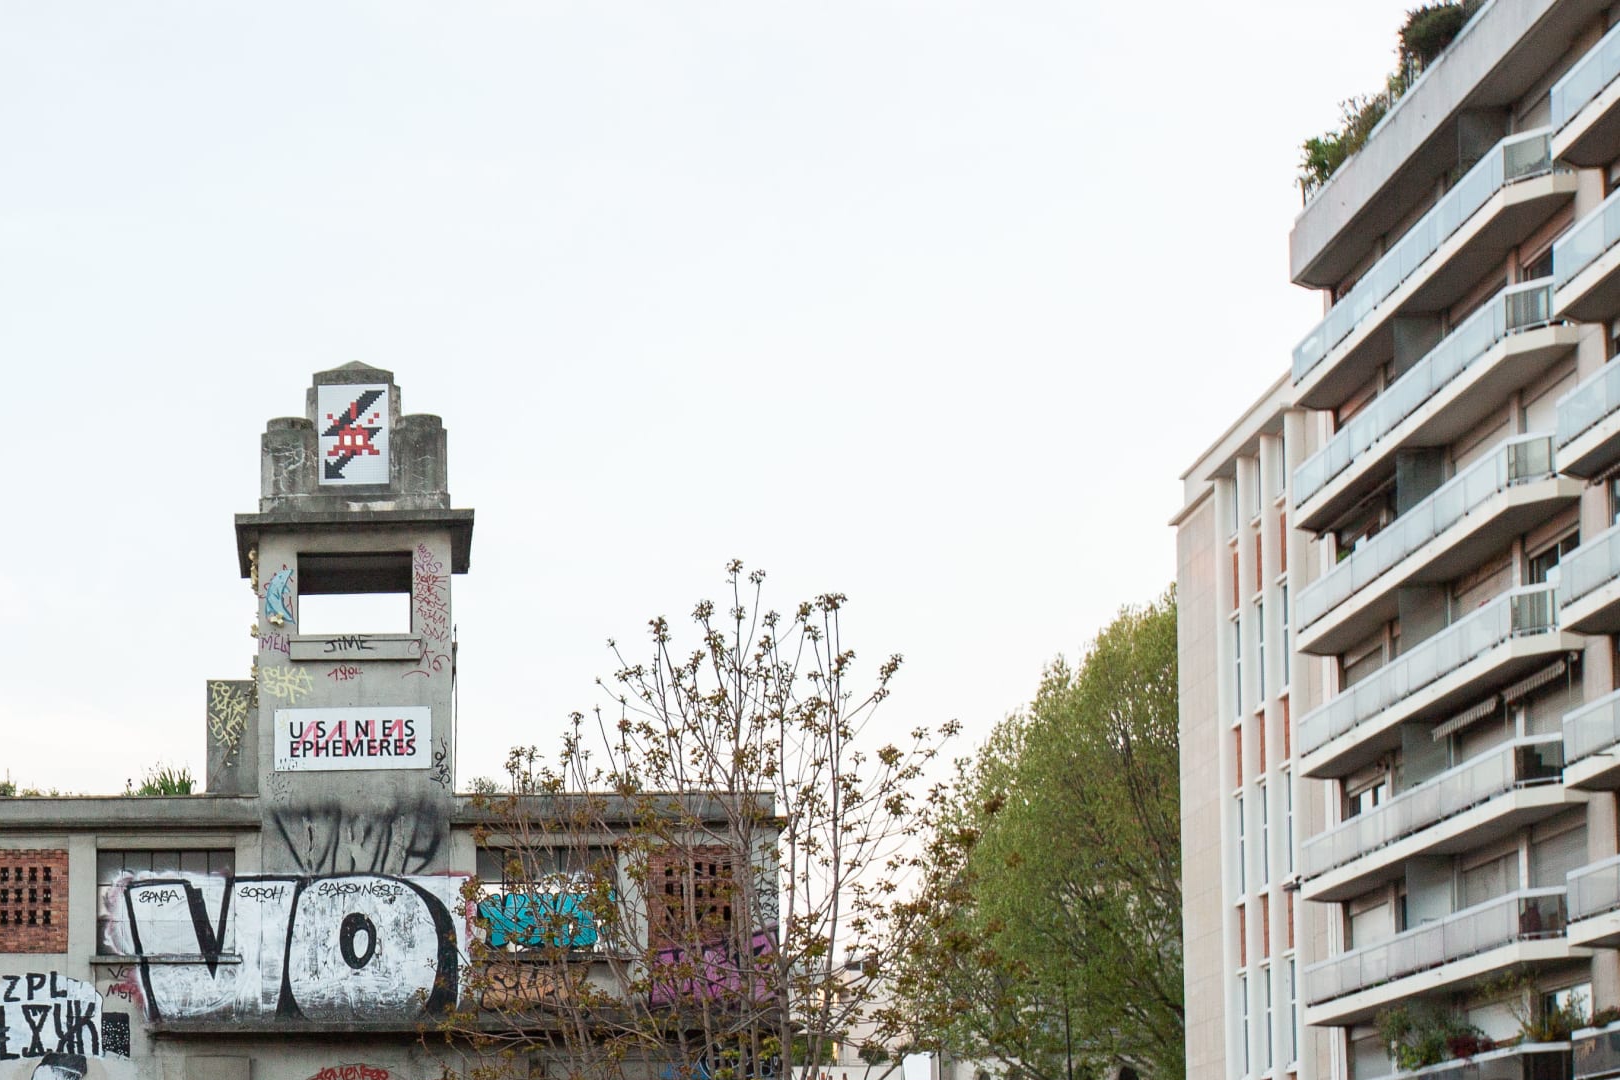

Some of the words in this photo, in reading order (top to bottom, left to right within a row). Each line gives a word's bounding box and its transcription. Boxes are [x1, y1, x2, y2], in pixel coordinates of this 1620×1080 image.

[289, 719, 415, 739] USINES
[289, 738, 417, 758] EPHEMERES
[3, 971, 68, 1003] ZPL
